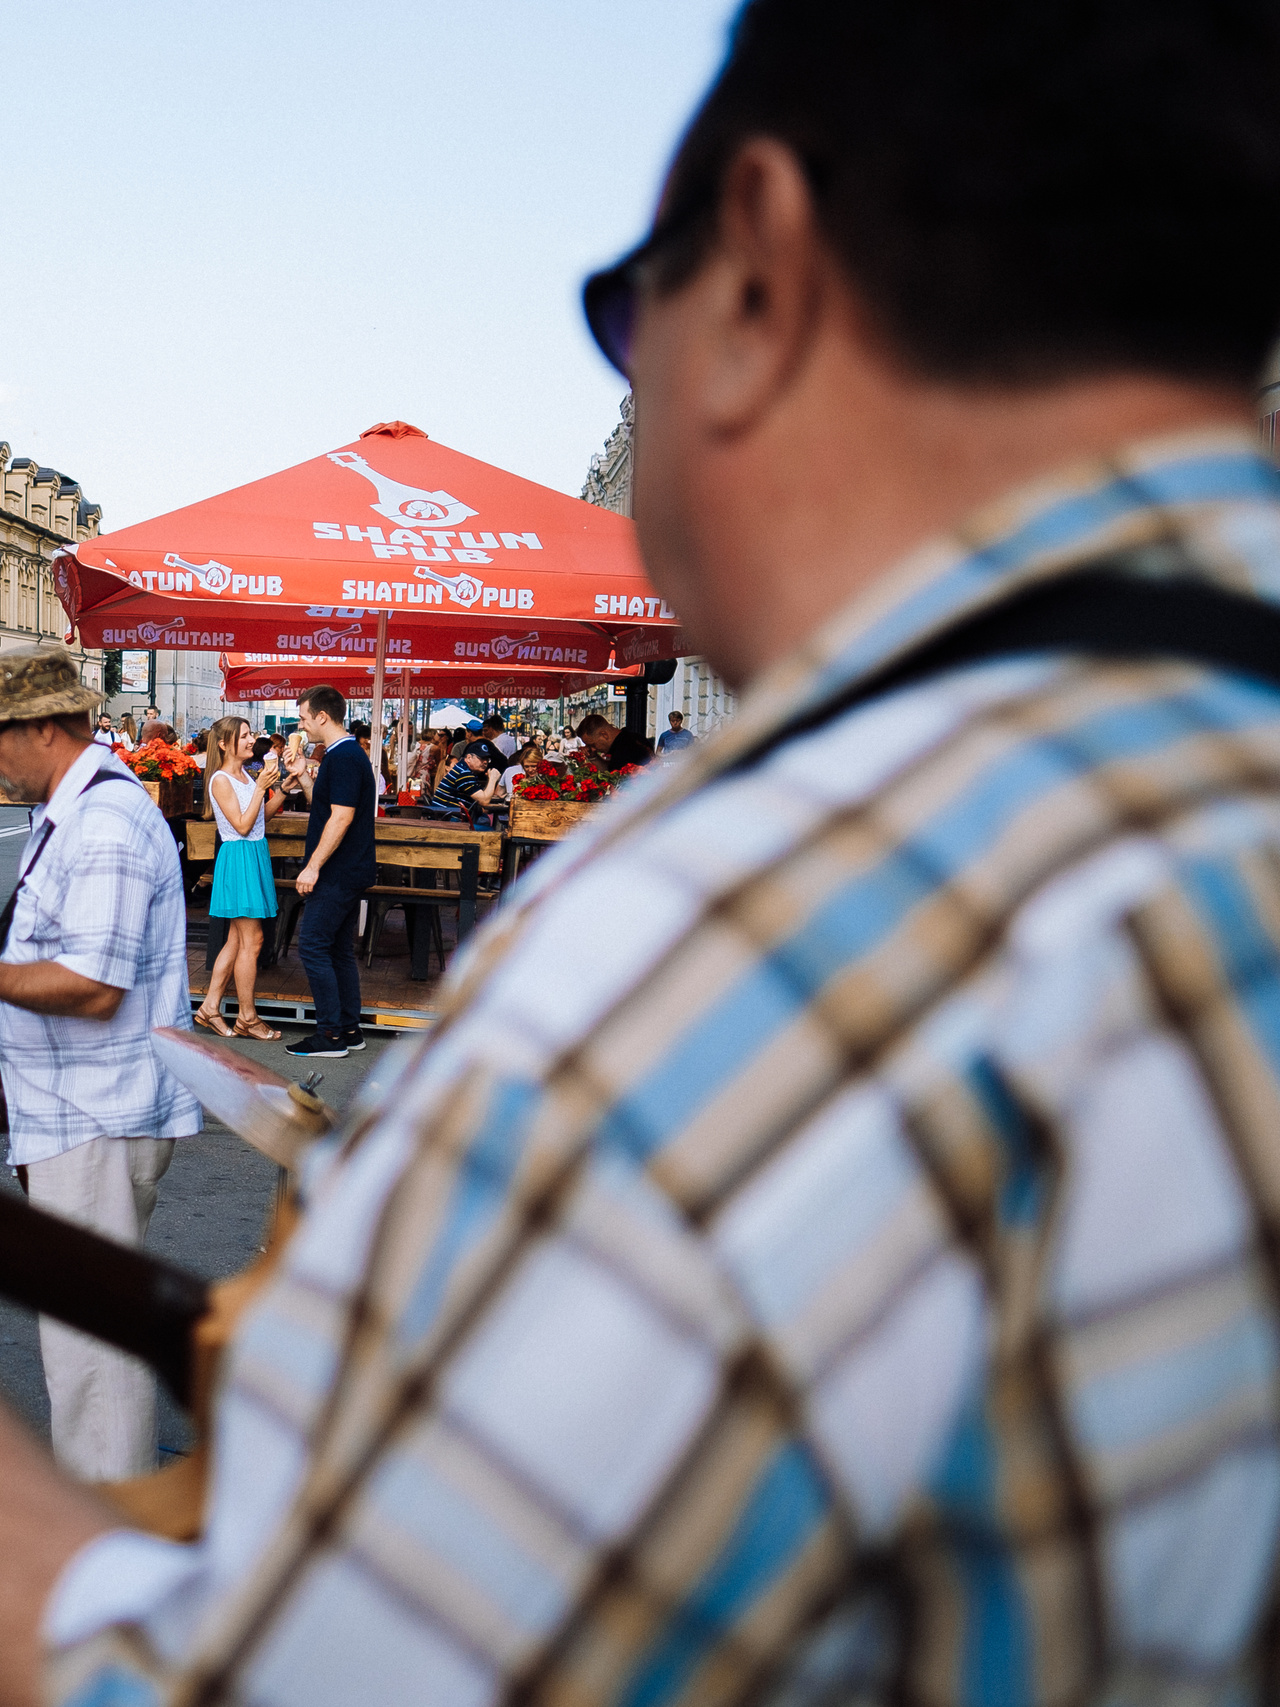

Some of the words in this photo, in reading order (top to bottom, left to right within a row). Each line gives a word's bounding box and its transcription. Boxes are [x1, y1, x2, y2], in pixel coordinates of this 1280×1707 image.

[312, 521, 544, 550] SHATUN
[371, 543, 495, 564] PUB
[122, 570, 193, 592] ATUN
[231, 573, 284, 596] PUB
[341, 579, 443, 605] SHATUN
[482, 587, 535, 610] PUB
[594, 594, 678, 619] SHATU
